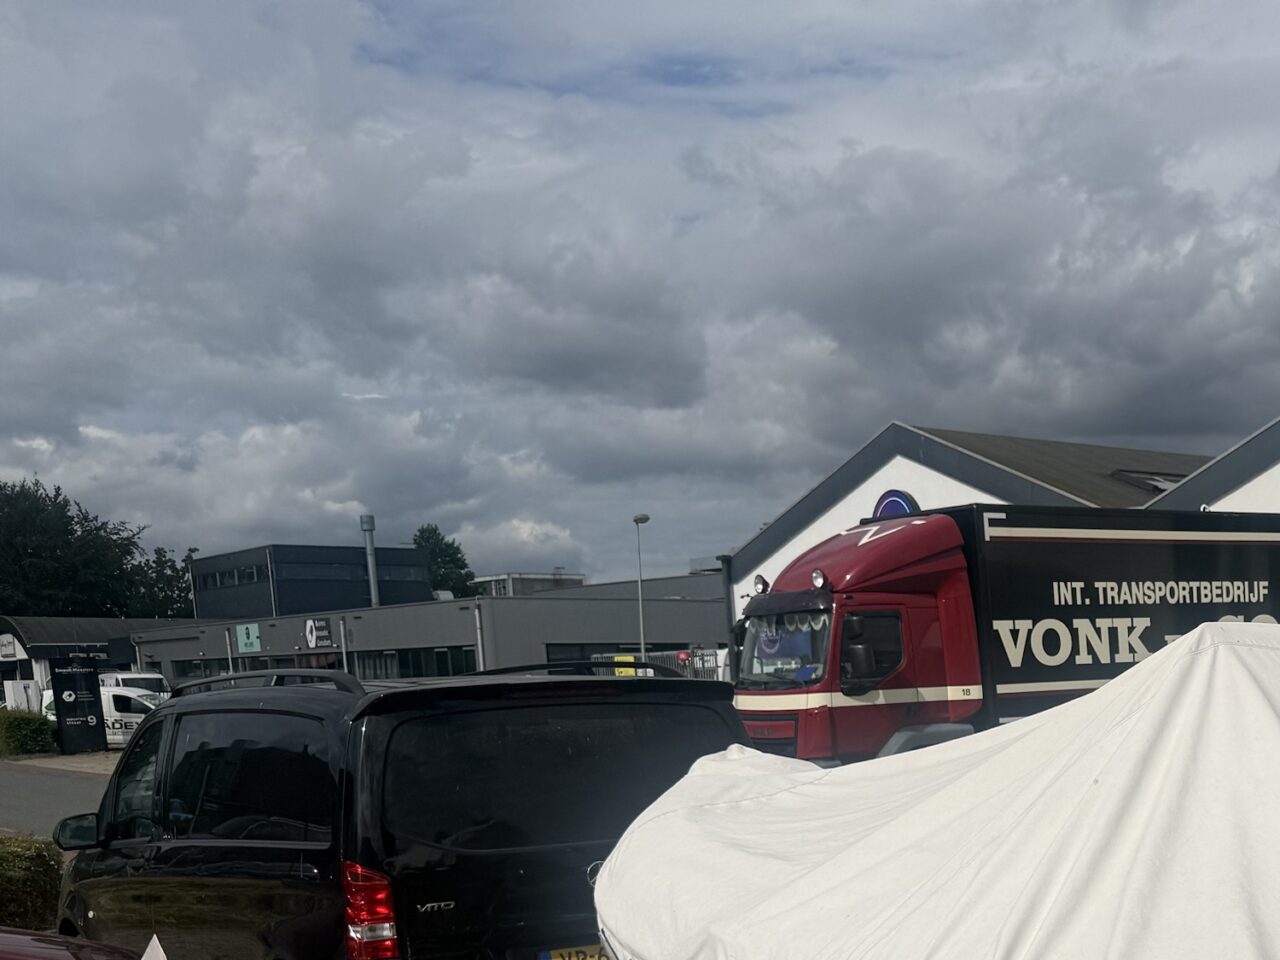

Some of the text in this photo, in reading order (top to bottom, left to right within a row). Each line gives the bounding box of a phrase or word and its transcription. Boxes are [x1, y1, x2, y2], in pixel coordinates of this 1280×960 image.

[1053, 581, 1269, 606] INT. TRANSPORTBEDRIJF
[992, 617, 1152, 667] VONK
[961, 688, 971, 696] 18
[87, 715, 97, 726] 9
